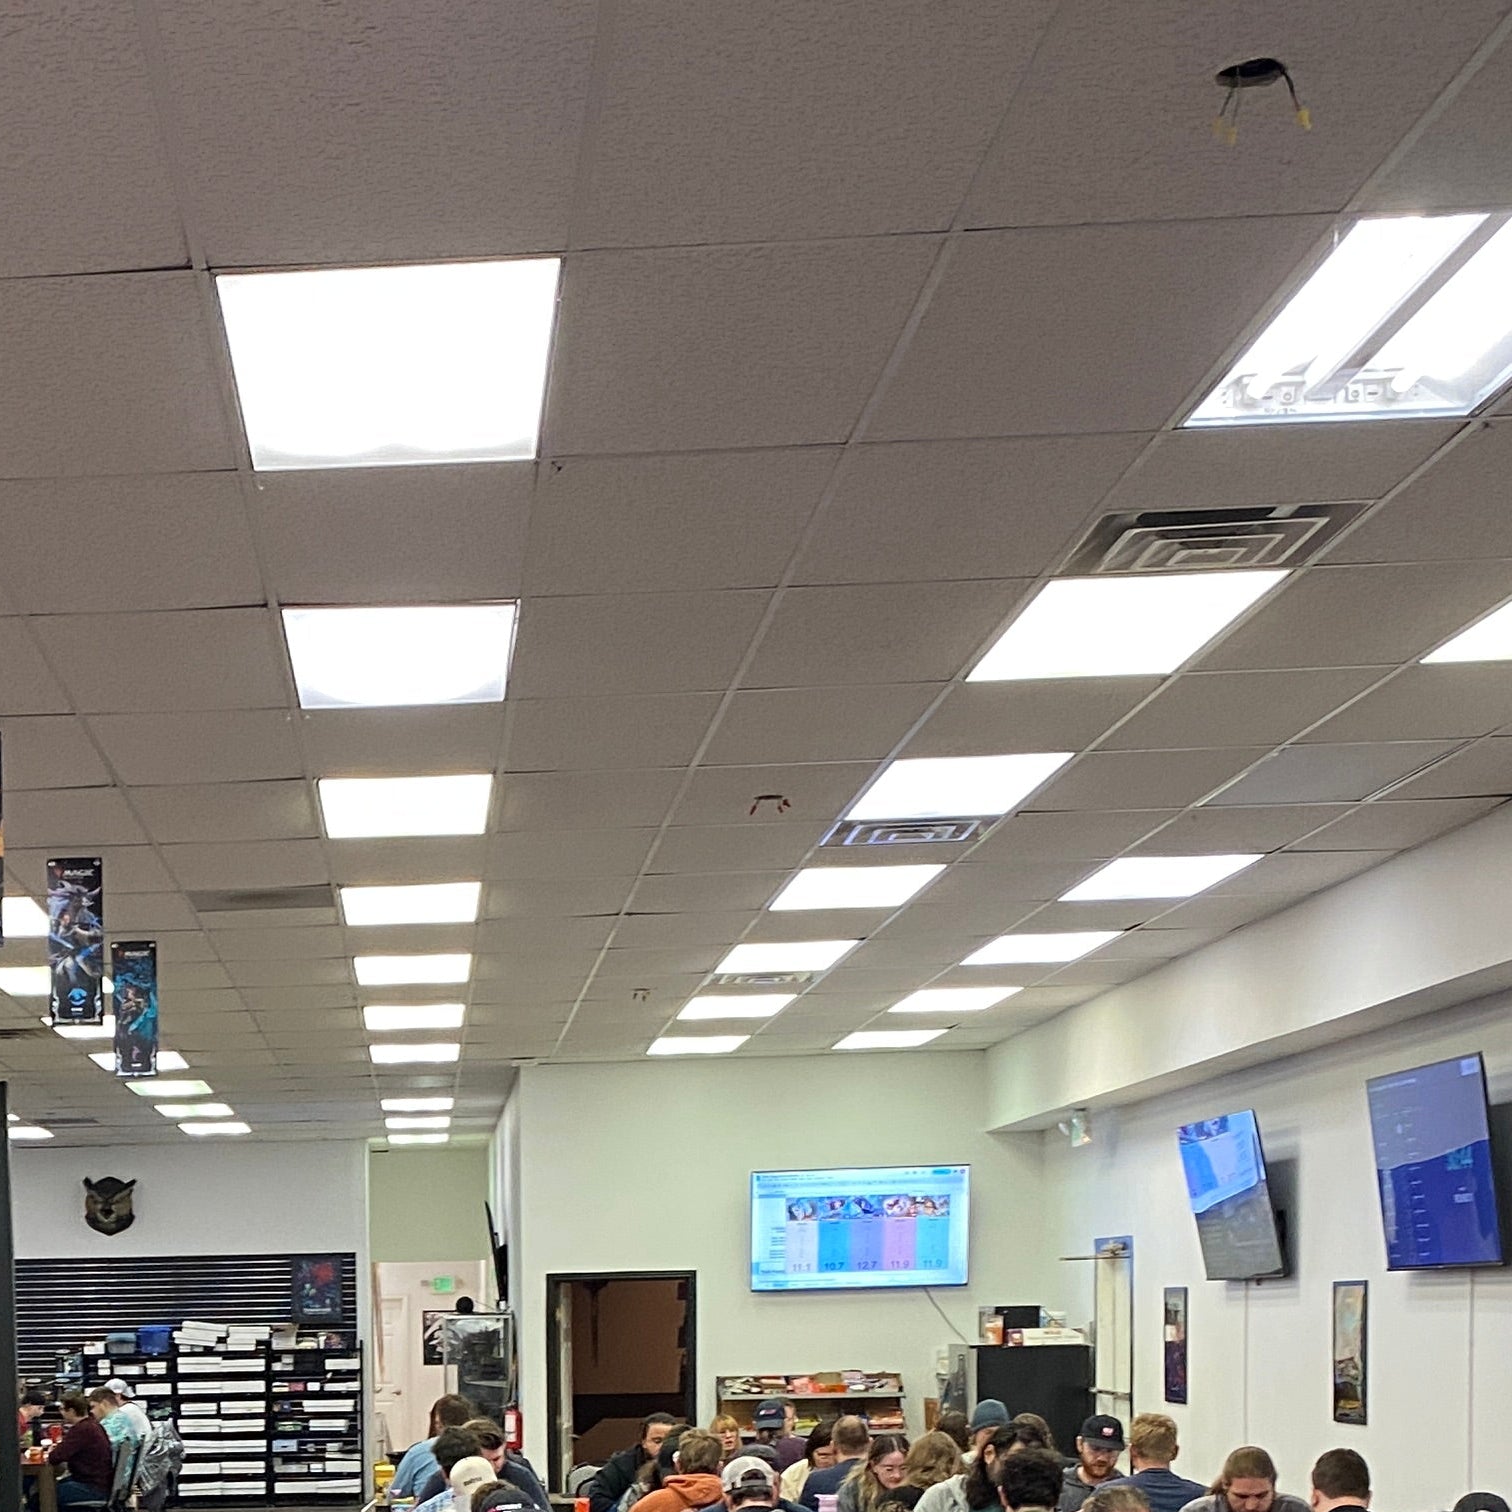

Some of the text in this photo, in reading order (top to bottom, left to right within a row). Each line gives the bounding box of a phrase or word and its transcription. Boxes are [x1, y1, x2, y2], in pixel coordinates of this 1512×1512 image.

[824, 1262, 845, 1270] 10.7
[857, 1261, 878, 1270] 12.7
[891, 1260, 910, 1269] 11.9
